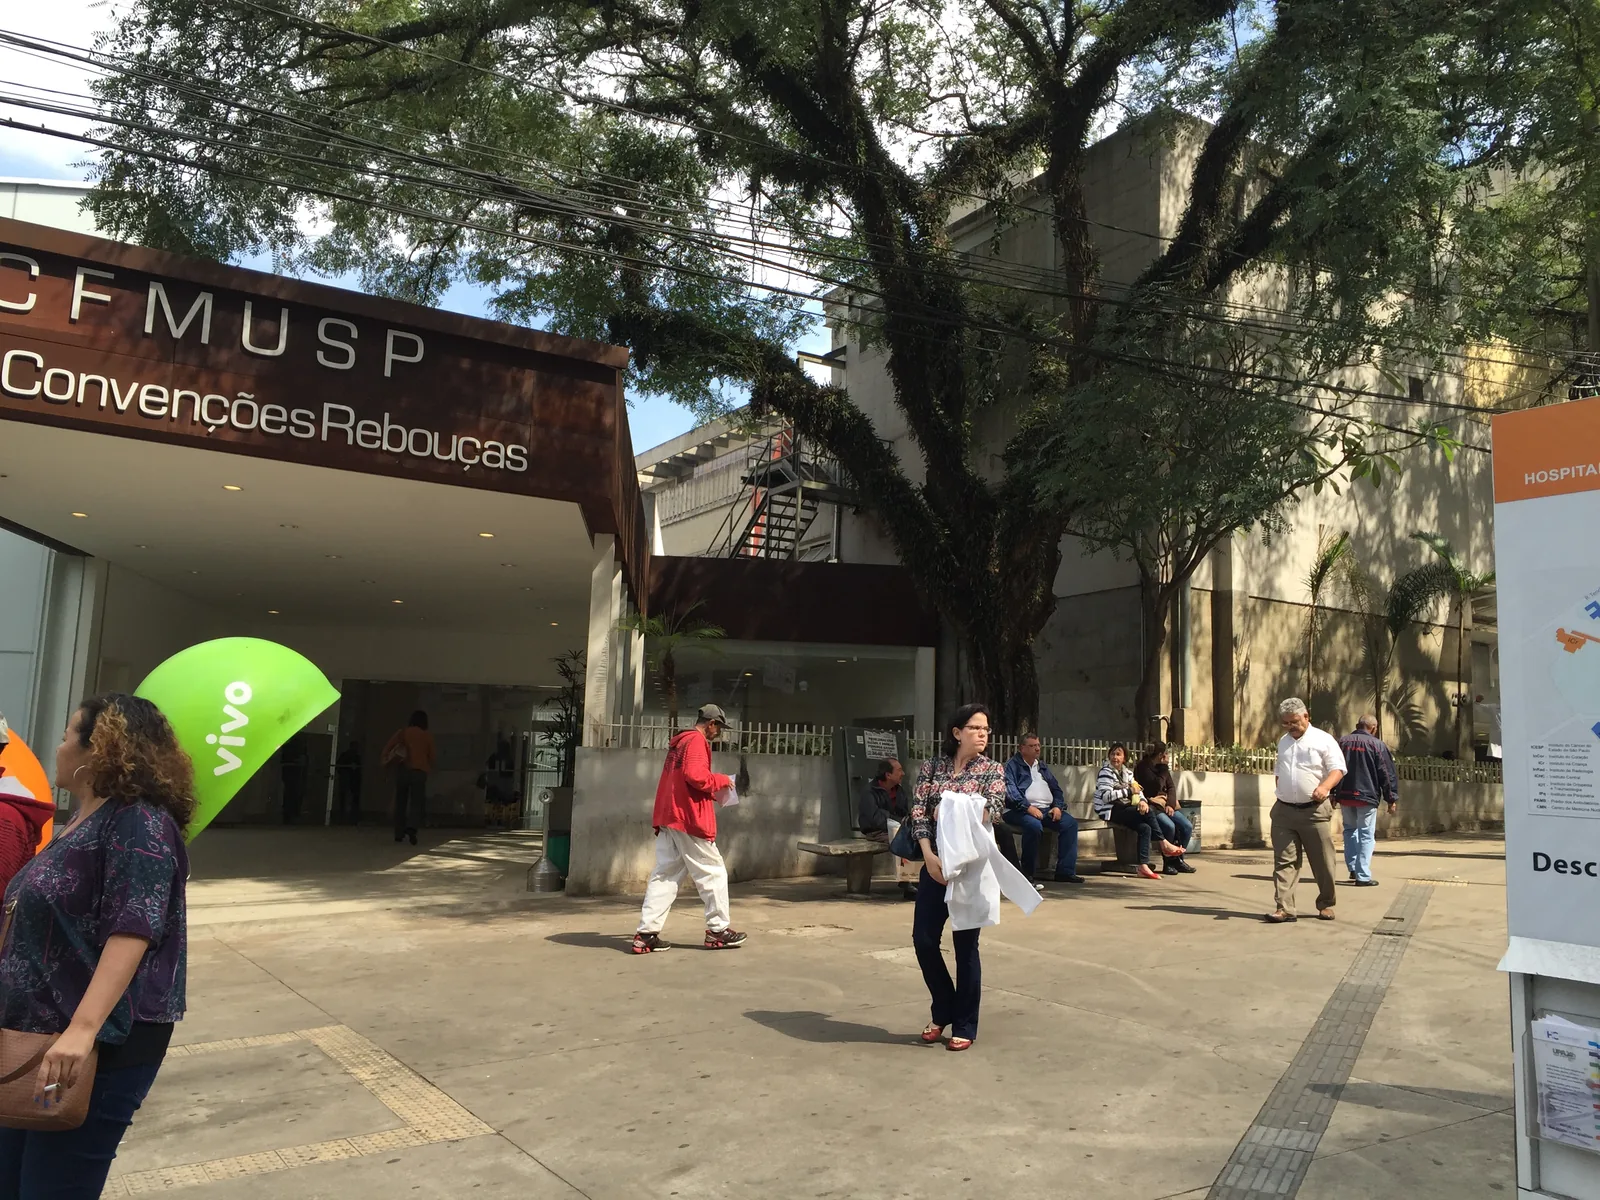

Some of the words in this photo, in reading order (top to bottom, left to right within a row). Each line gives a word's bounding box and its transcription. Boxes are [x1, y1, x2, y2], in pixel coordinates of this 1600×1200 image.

[1524, 462, 1600, 485] HOSPITA
[206, 681, 252, 776] vivo
[1533, 851, 1598, 877] Desc
